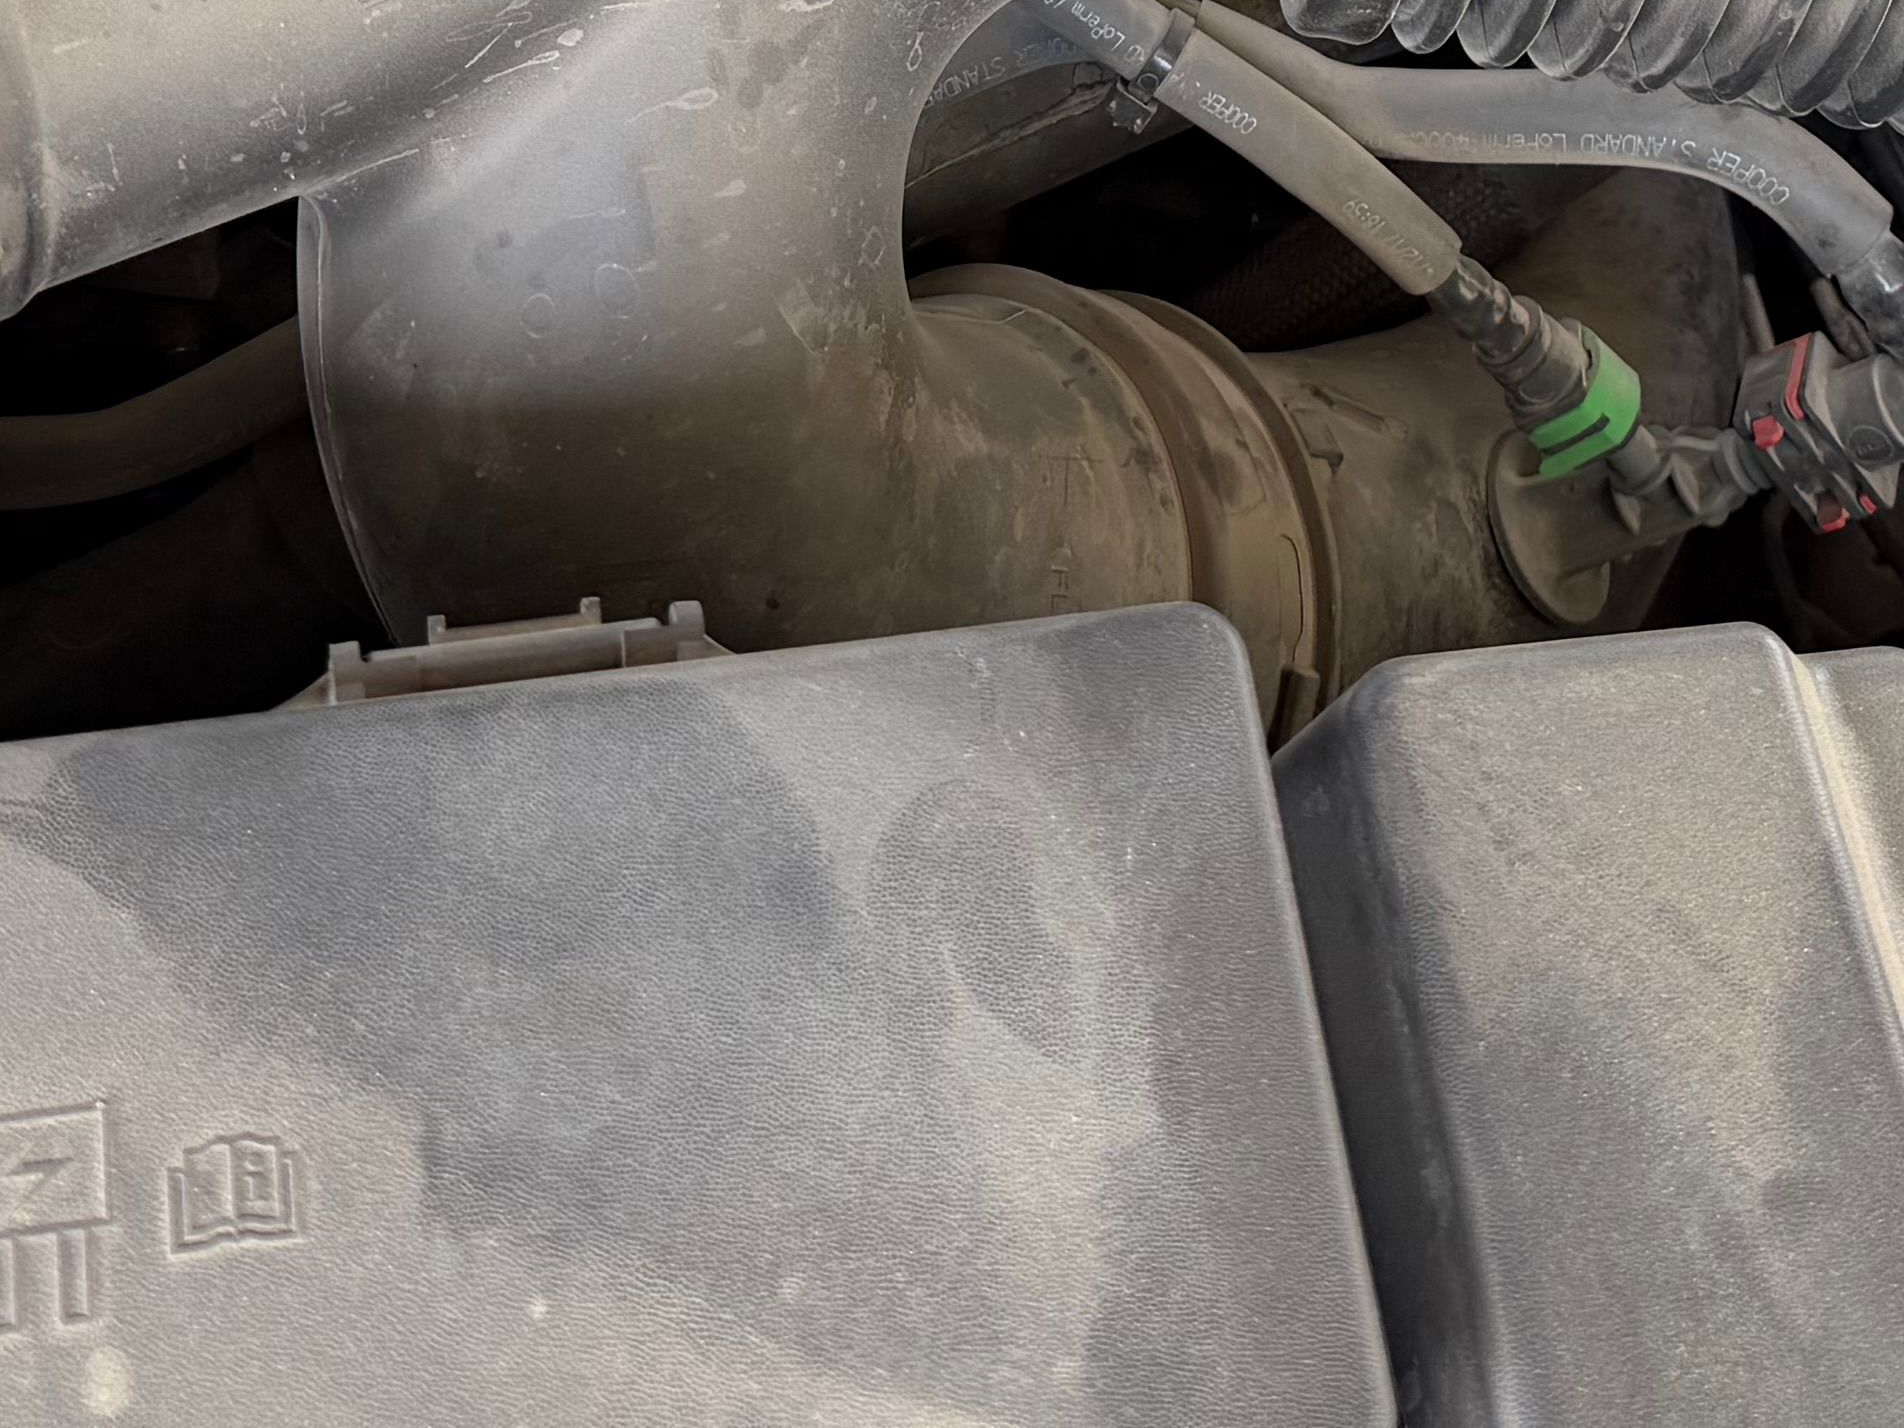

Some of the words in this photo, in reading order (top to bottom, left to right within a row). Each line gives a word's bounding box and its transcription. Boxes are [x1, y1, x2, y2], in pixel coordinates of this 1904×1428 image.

[1072, 1, 1125, 48] LoPerm
[1200, 92, 1257, 135] COOPER
[1707, 146, 1790, 205] COOPER
